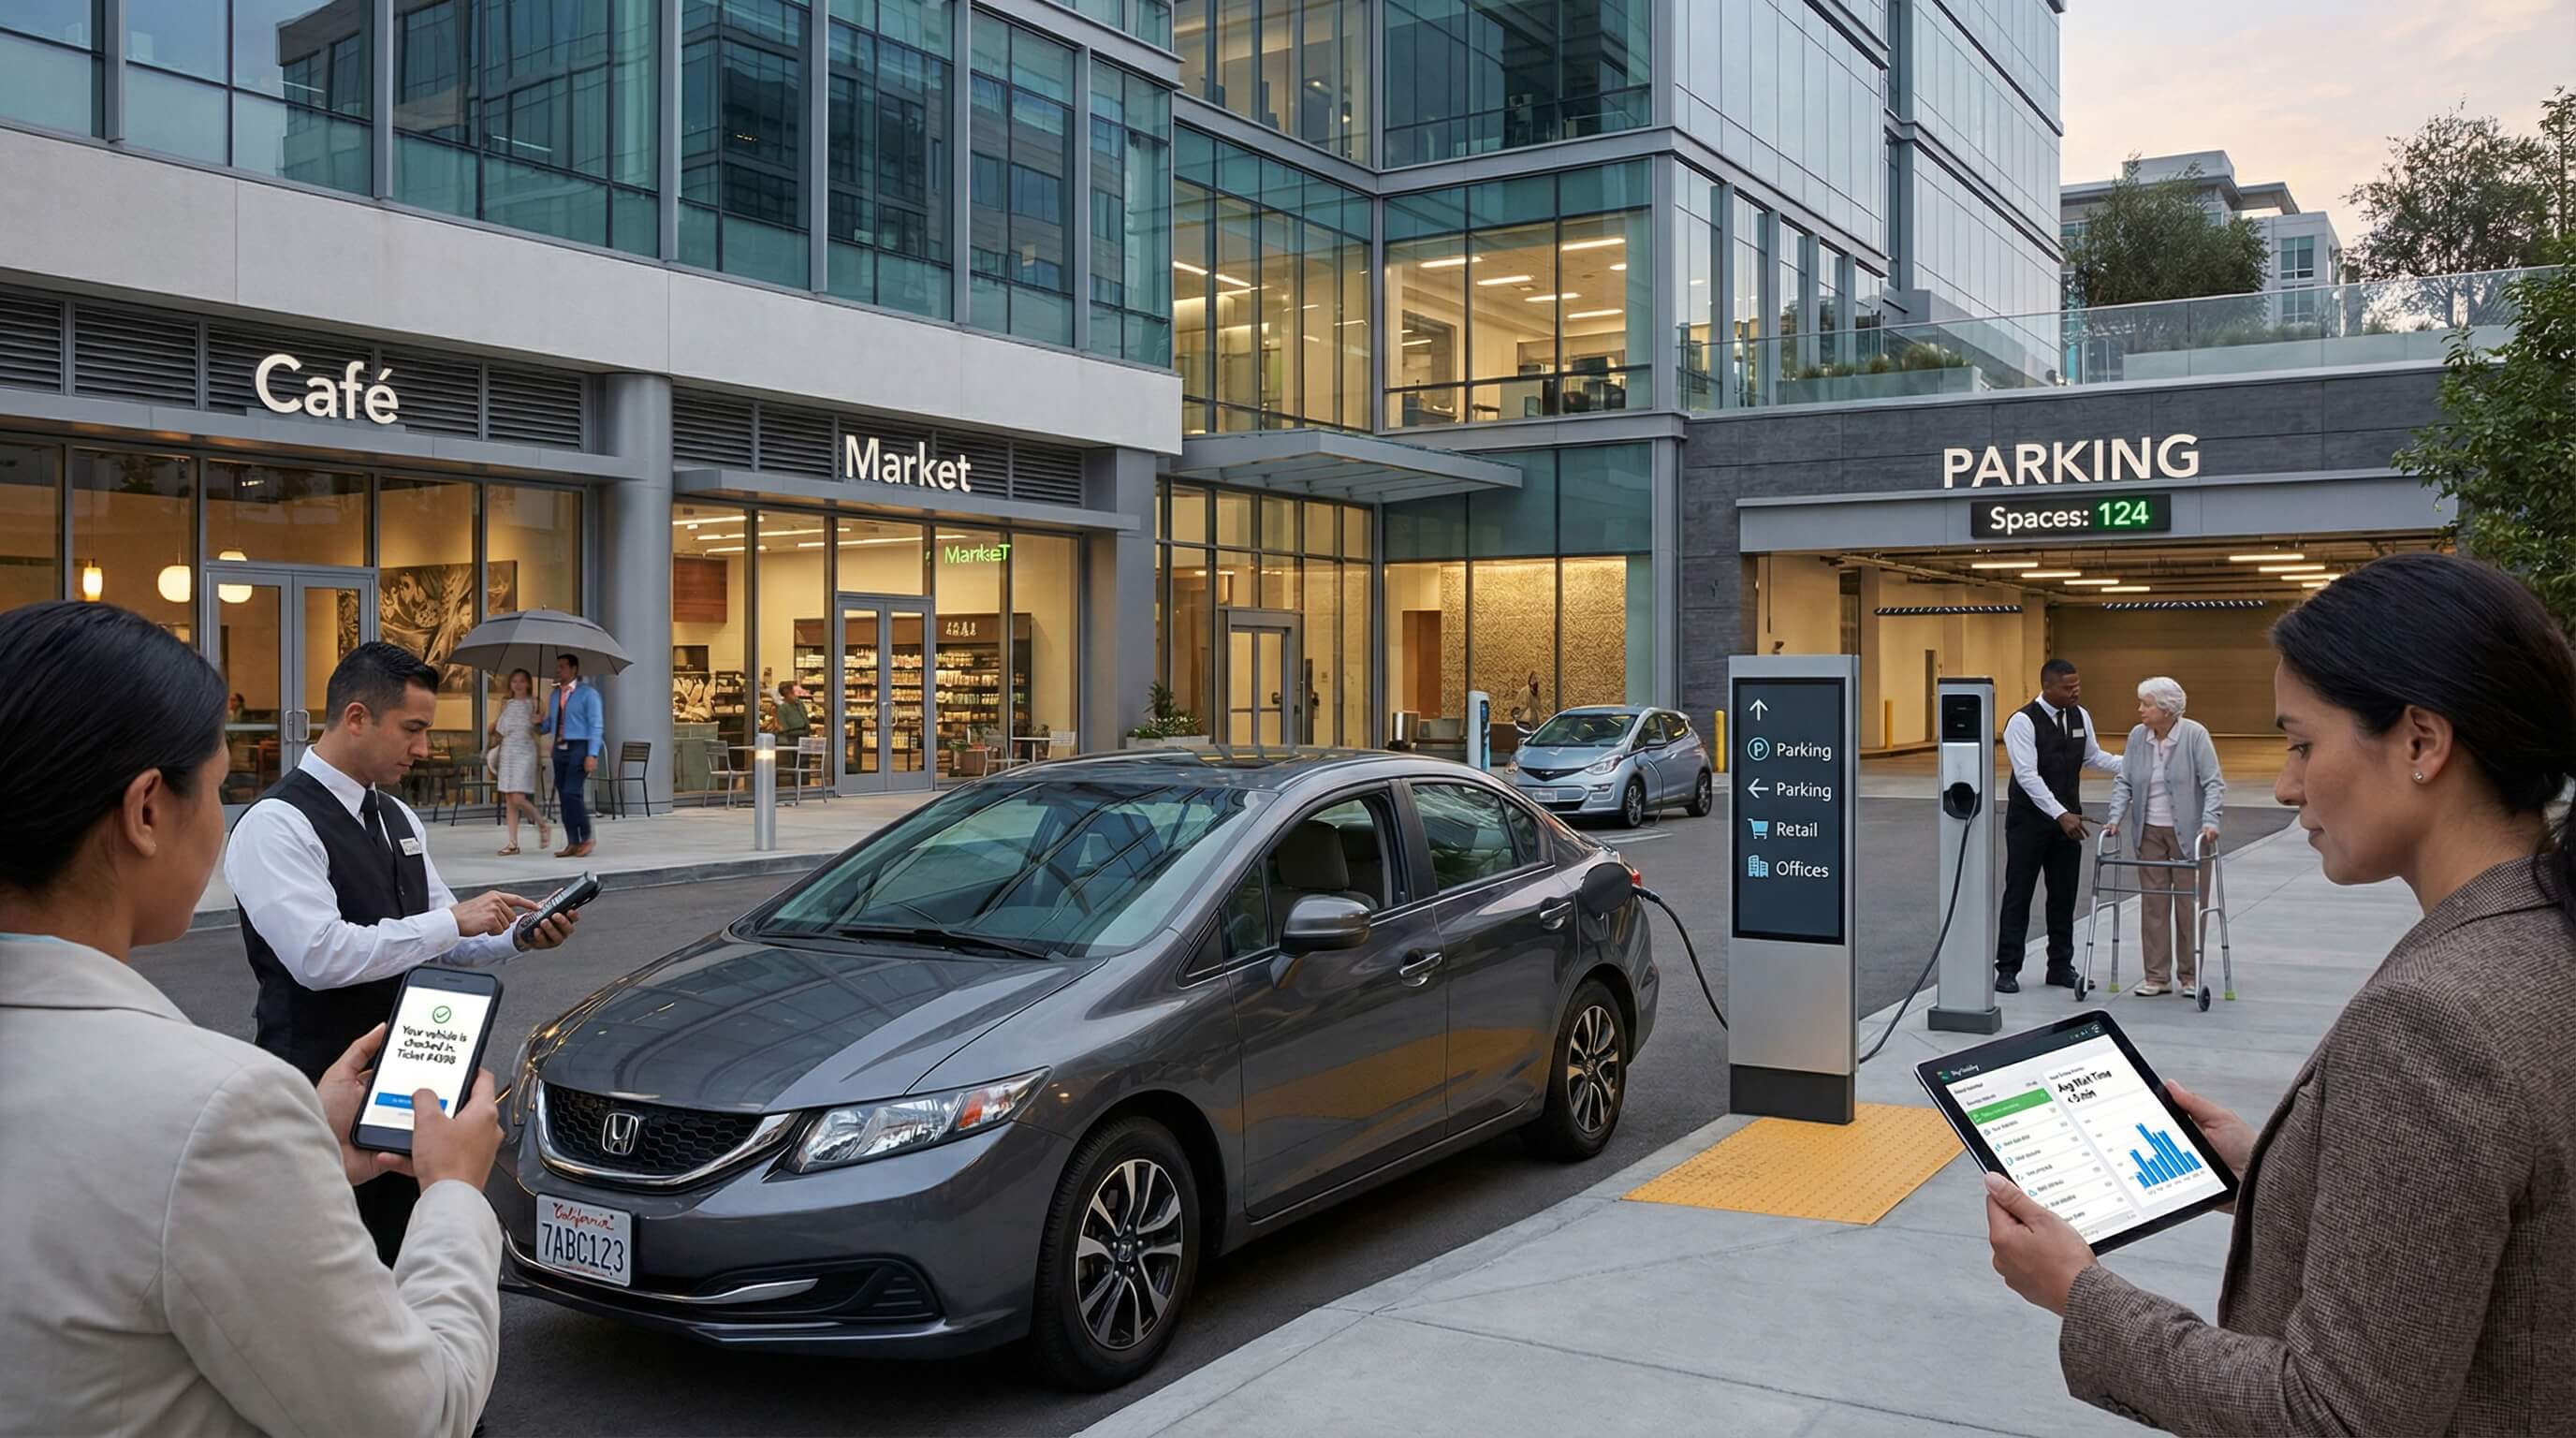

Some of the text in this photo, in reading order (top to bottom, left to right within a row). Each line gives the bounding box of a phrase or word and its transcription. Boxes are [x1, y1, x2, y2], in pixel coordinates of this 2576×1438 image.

[256, 353, 399, 424] Café
[845, 434, 971, 492] Market
[1943, 433, 2199, 489] PARKING
[1990, 501, 2149, 536] Spaces: 124
[1777, 741, 1832, 761] Parking
[1777, 782, 1832, 801] Parking
[1777, 822, 1818, 837] Retail
[1776, 860, 1829, 878] Offices
[402, 1025, 424, 1036] Your
[460, 1033, 467, 1042] is
[554, 1204, 614, 1230] California
[542, 1222, 623, 1272] 7ABC123
